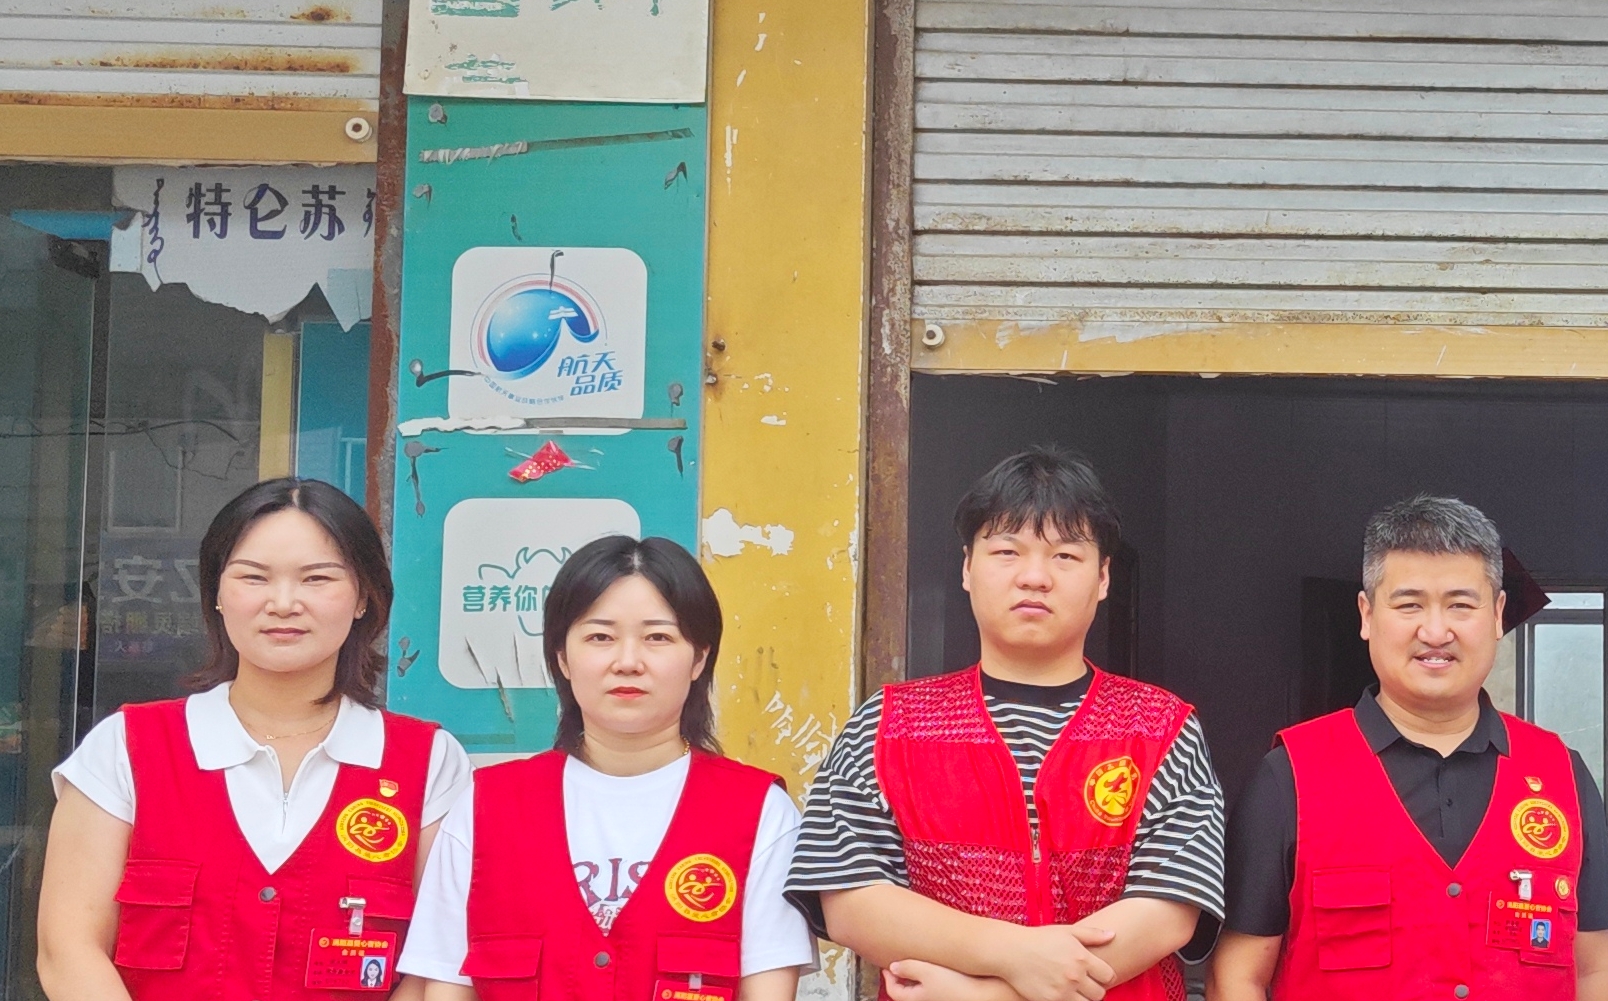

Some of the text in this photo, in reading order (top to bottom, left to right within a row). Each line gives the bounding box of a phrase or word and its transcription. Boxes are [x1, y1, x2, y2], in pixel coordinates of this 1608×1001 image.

[186, 182, 346, 241] 特仑苏
[556, 350, 617, 378] 航天
[569, 369, 624, 397] 品质
[462, 584, 552, 613] 营养你
